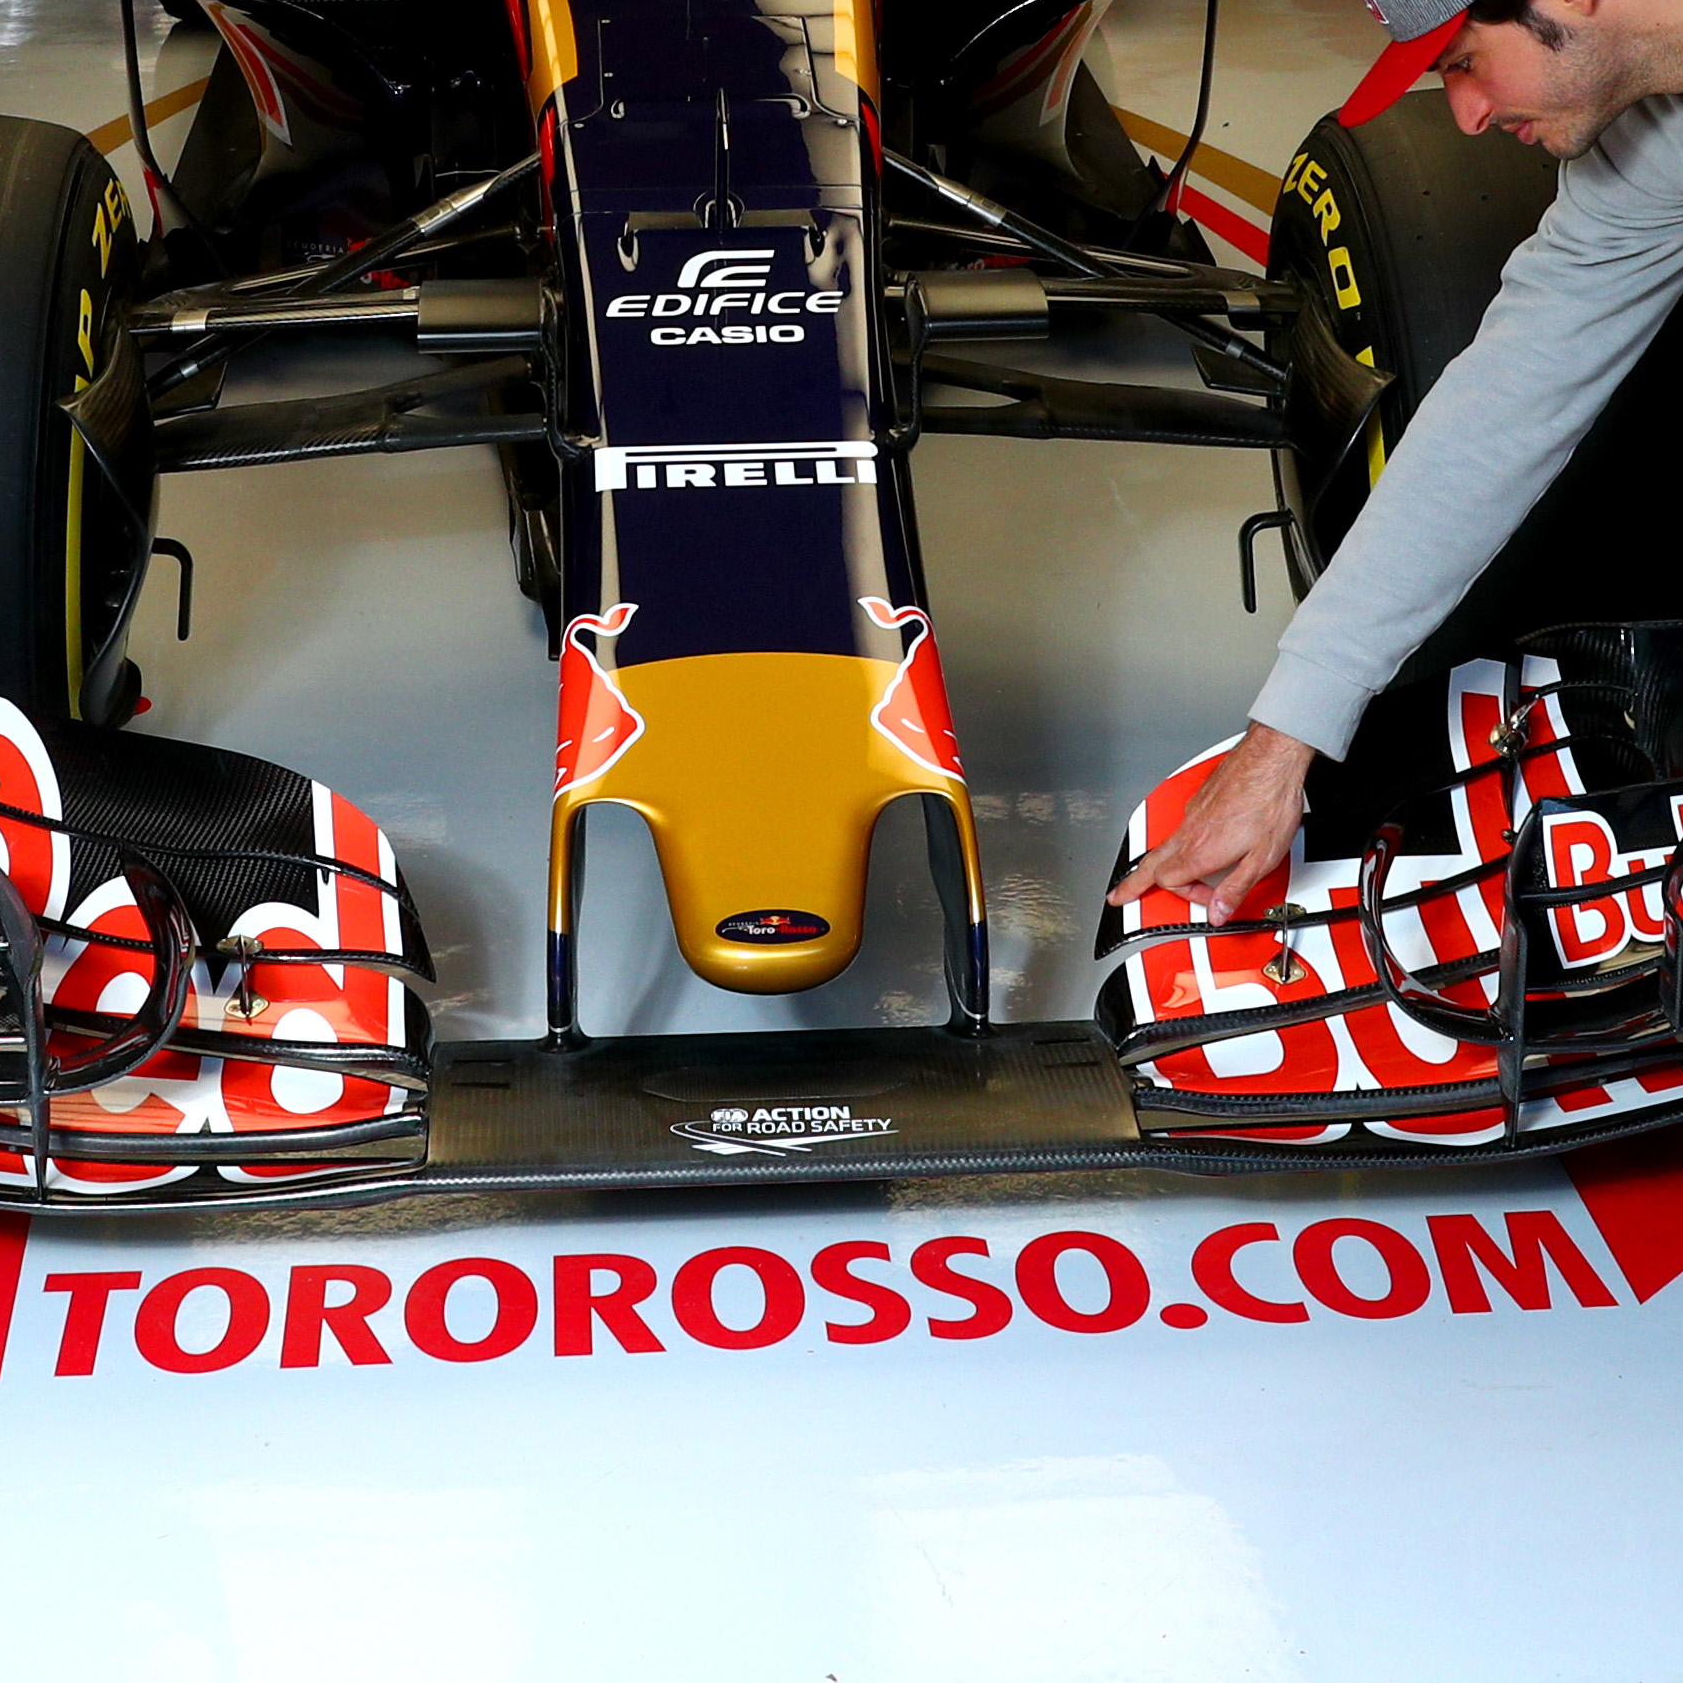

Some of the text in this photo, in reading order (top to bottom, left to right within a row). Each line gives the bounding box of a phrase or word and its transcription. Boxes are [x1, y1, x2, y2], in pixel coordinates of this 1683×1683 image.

[1282, 150, 1363, 311] ZERO
[606, 290, 844, 318] EDIFICE
[649, 325, 806, 346] CASIO
[595, 441, 879, 493] PIRELLI
[745, 924, 776, 935] Toro
[712, 1118, 892, 1134] FOR ROAD SAFETY
[752, 1106, 850, 1122] ACTION
[43, 1209, 1621, 1379] TOROROSSO.COM
